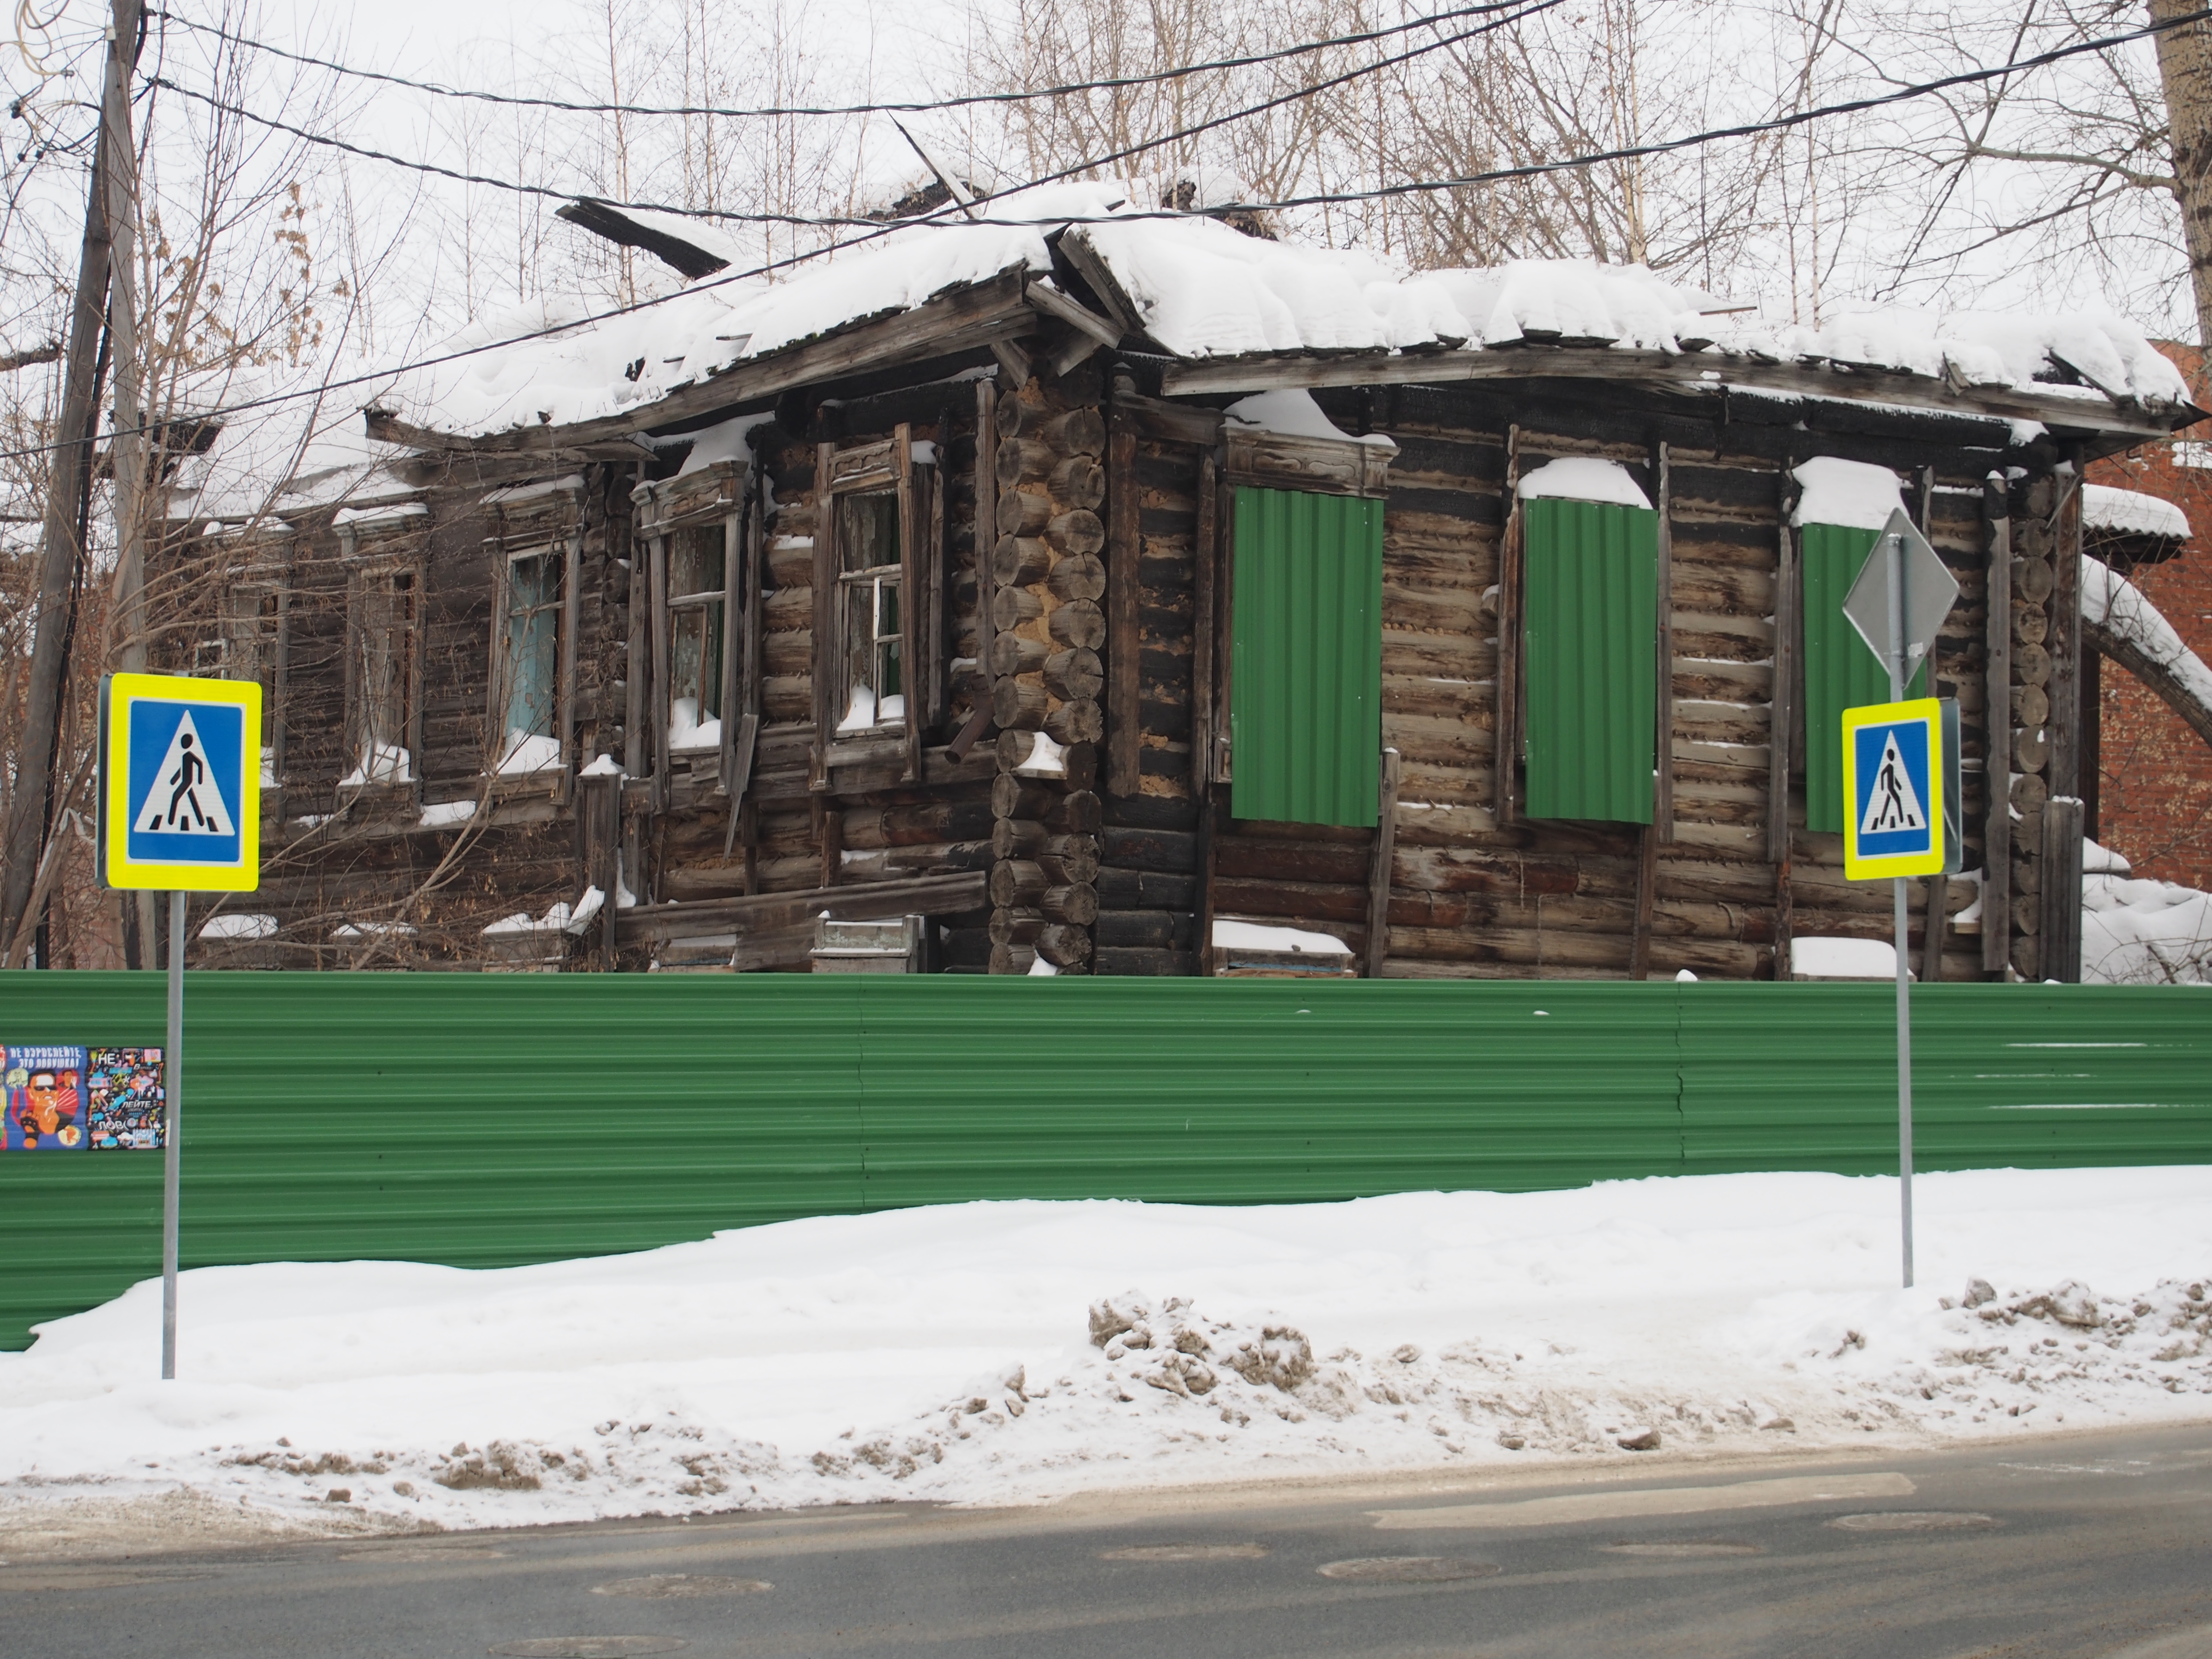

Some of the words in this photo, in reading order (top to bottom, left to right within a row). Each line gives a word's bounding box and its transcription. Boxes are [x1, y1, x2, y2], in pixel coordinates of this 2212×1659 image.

[10, 1047, 22, 1058] НЕ
[19, 1058, 34, 1069] ЭТО
[36, 1058, 79, 1069] ЛОВУШКА!
[98, 1053, 115, 1064] НЕ
[121, 1099, 152, 1108] ЛЕЙТЕ,
